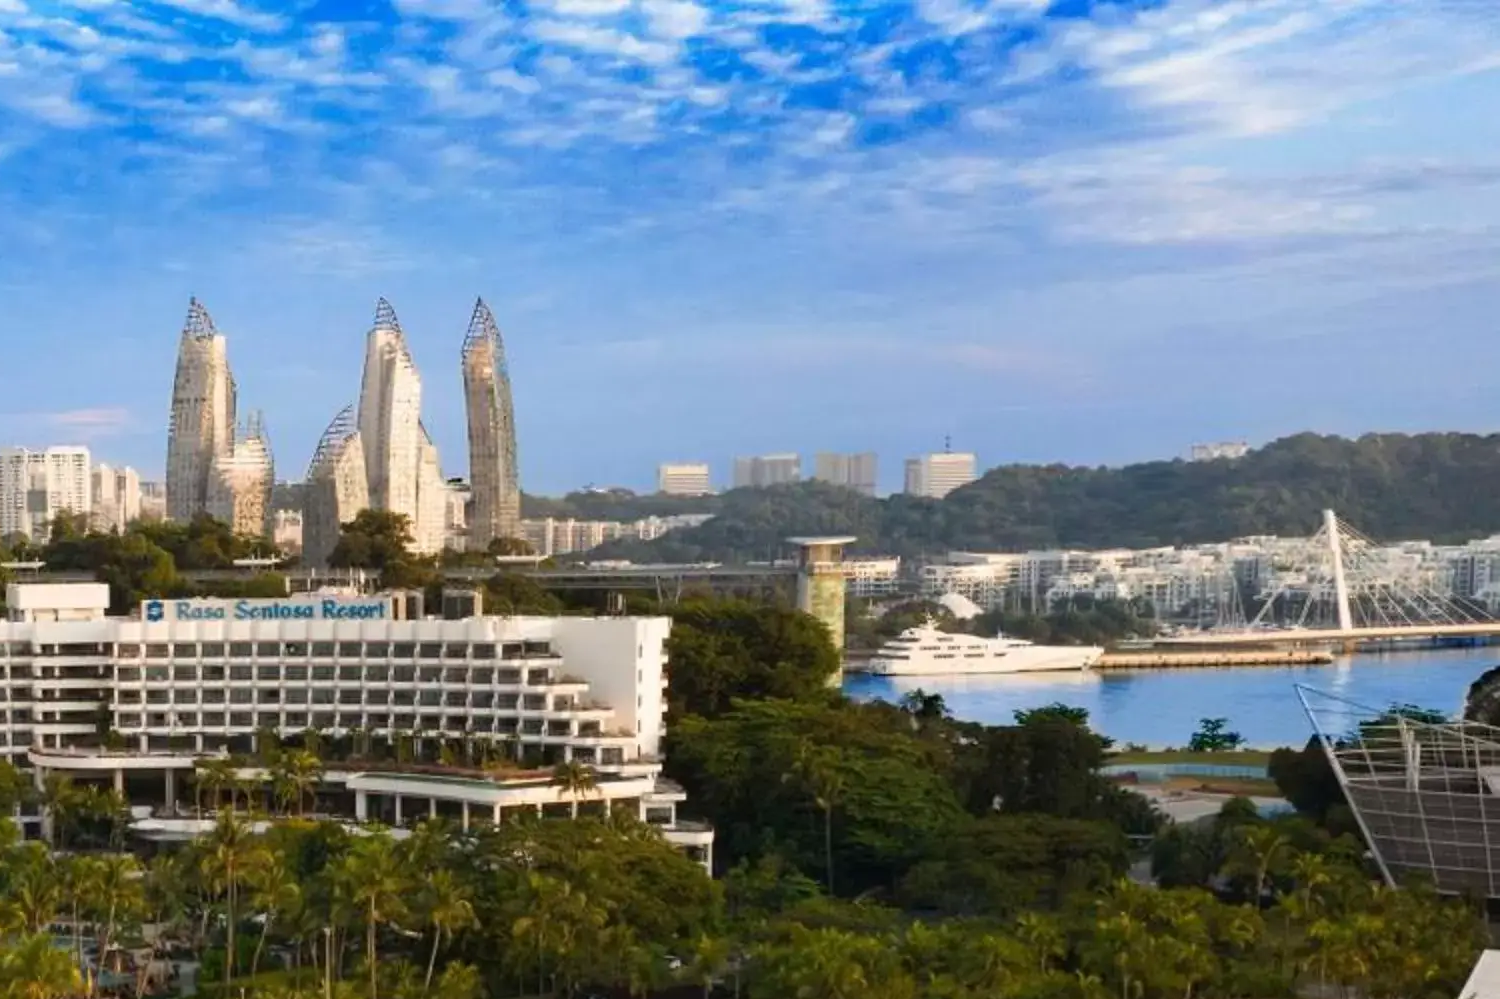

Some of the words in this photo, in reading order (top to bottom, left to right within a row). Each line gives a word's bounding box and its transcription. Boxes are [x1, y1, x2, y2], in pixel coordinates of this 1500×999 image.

[176, 602, 225, 620] Rasa
[234, 600, 314, 619] Sentosa
[322, 600, 385, 619] Resort
